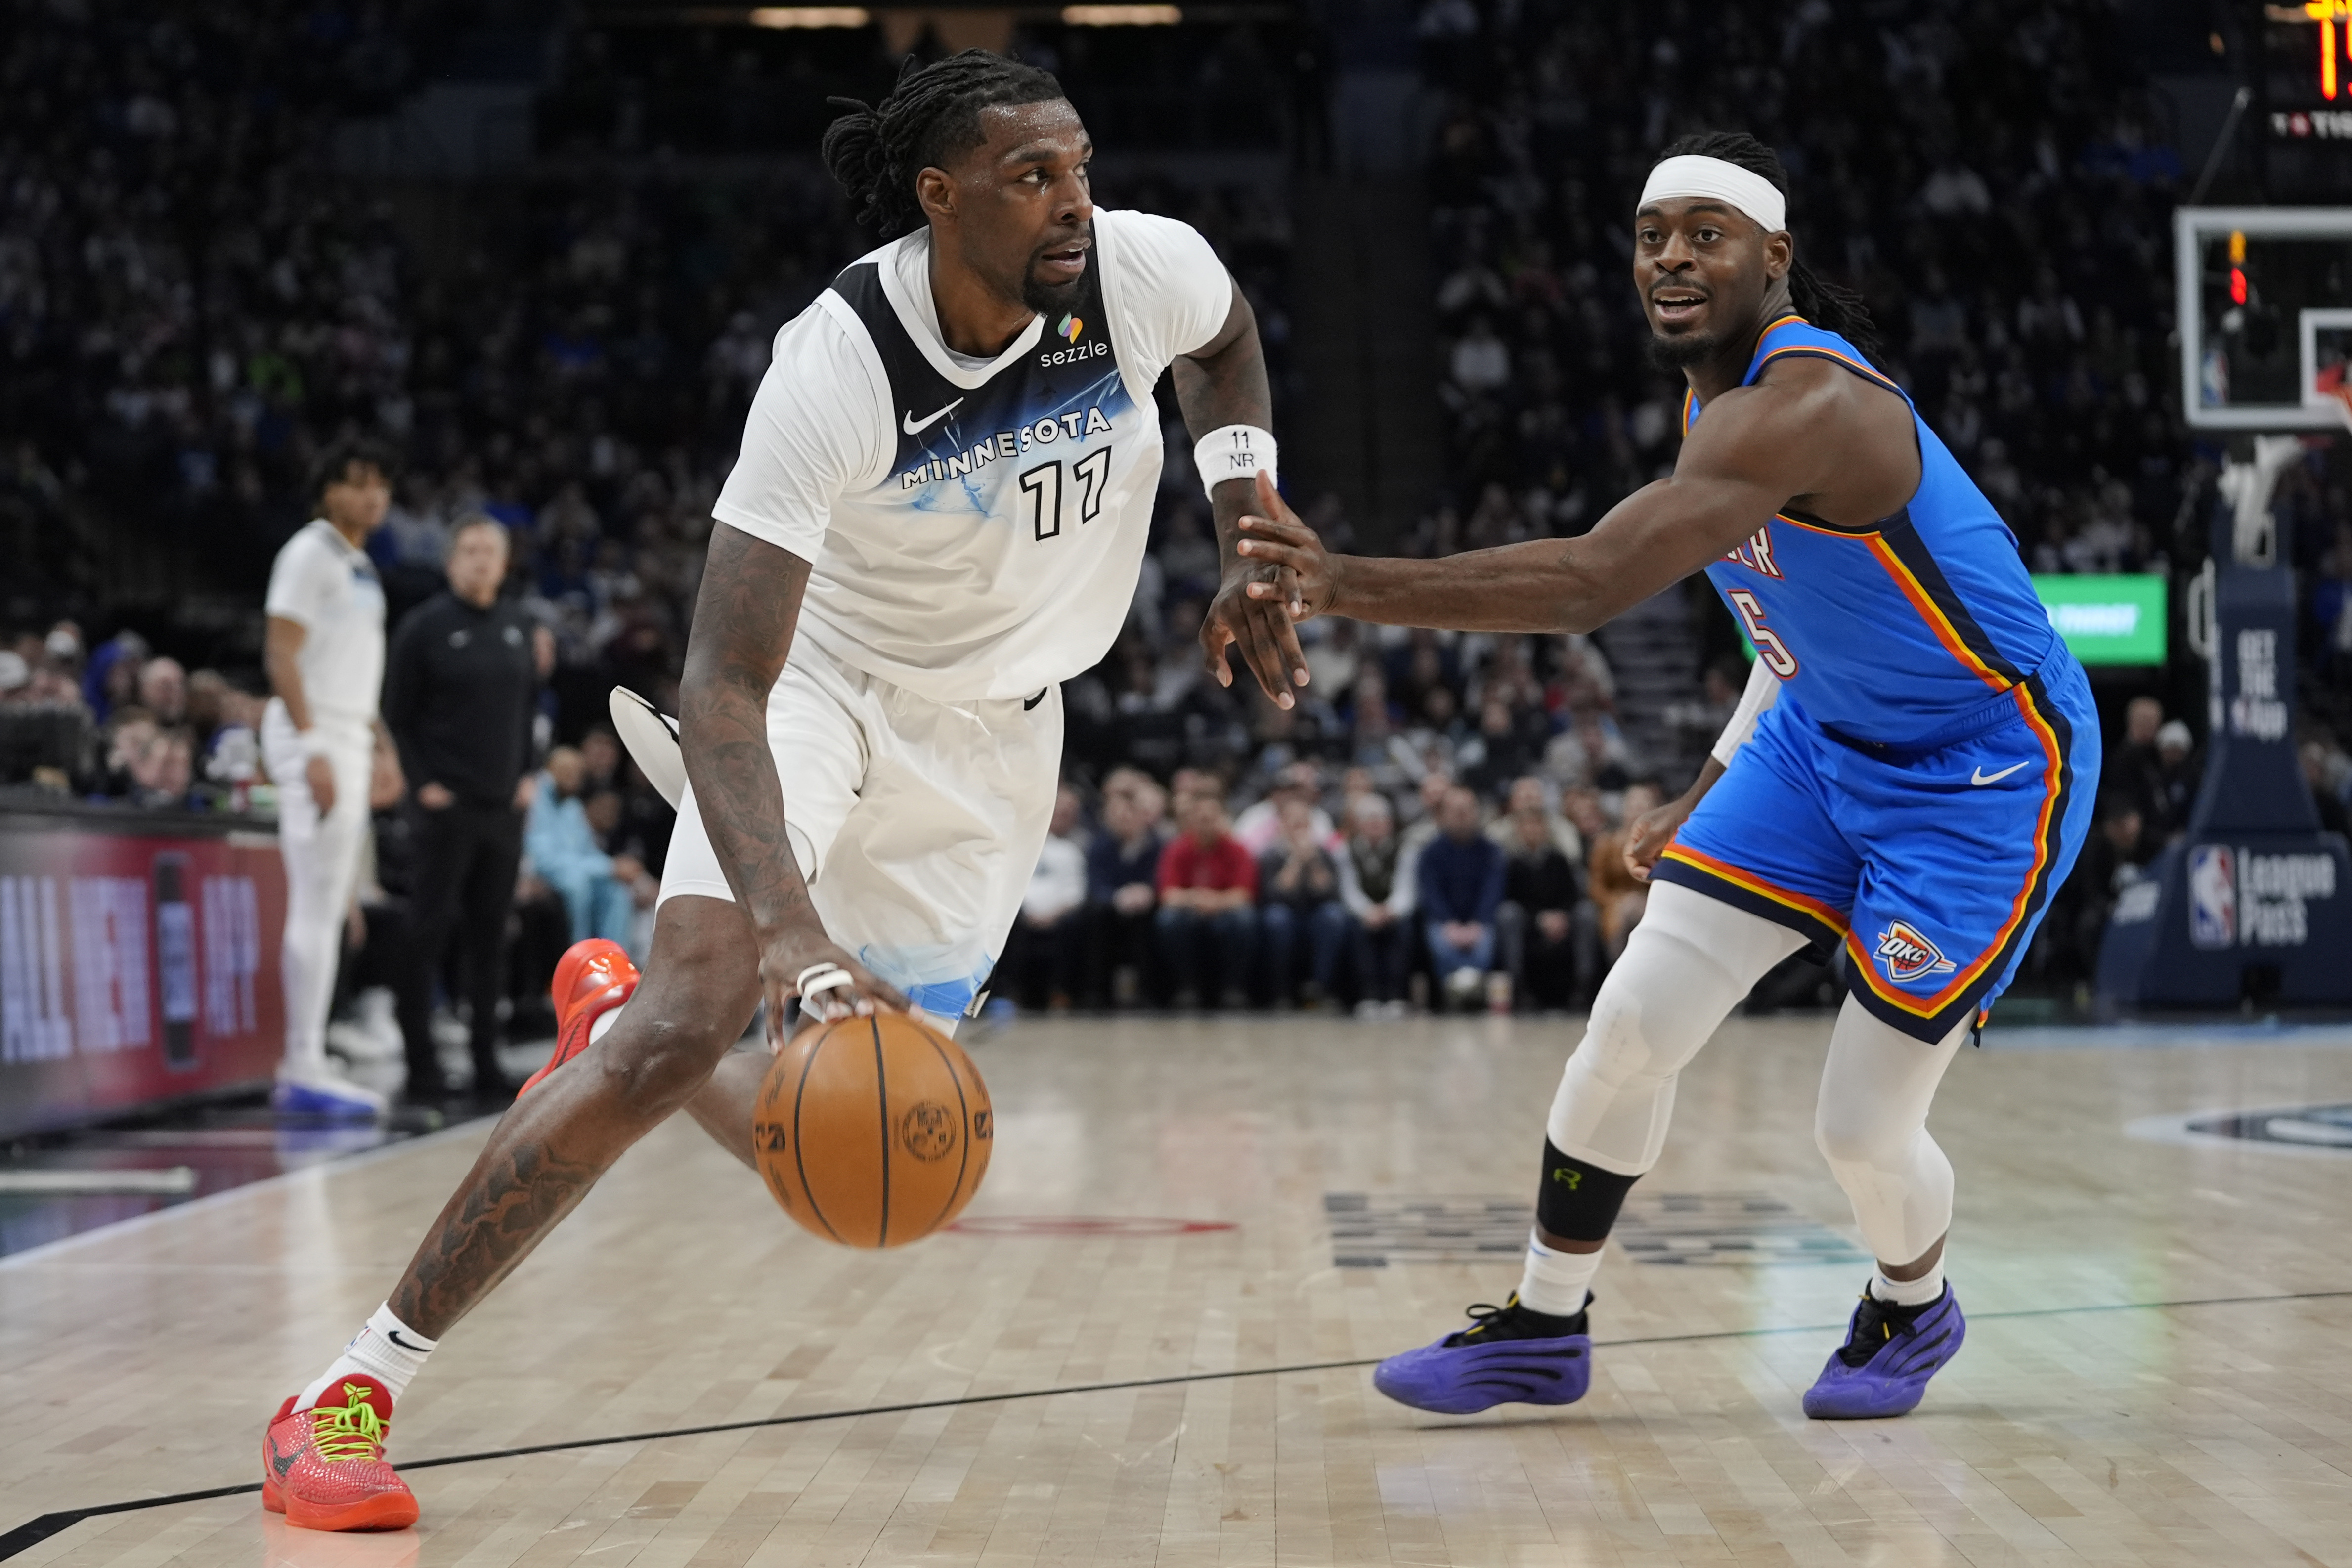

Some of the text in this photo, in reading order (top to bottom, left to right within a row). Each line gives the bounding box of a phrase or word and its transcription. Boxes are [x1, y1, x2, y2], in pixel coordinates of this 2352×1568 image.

[1041, 339, 1108, 367] sezzle
[902, 406, 1112, 489] MINNESOTA
[1230, 431, 1249, 449] 11
[1230, 453, 1254, 470] NR
[1019, 445, 1112, 541] 11
[1726, 588, 1799, 680] 5
[1879, 938, 1928, 962] OKC
